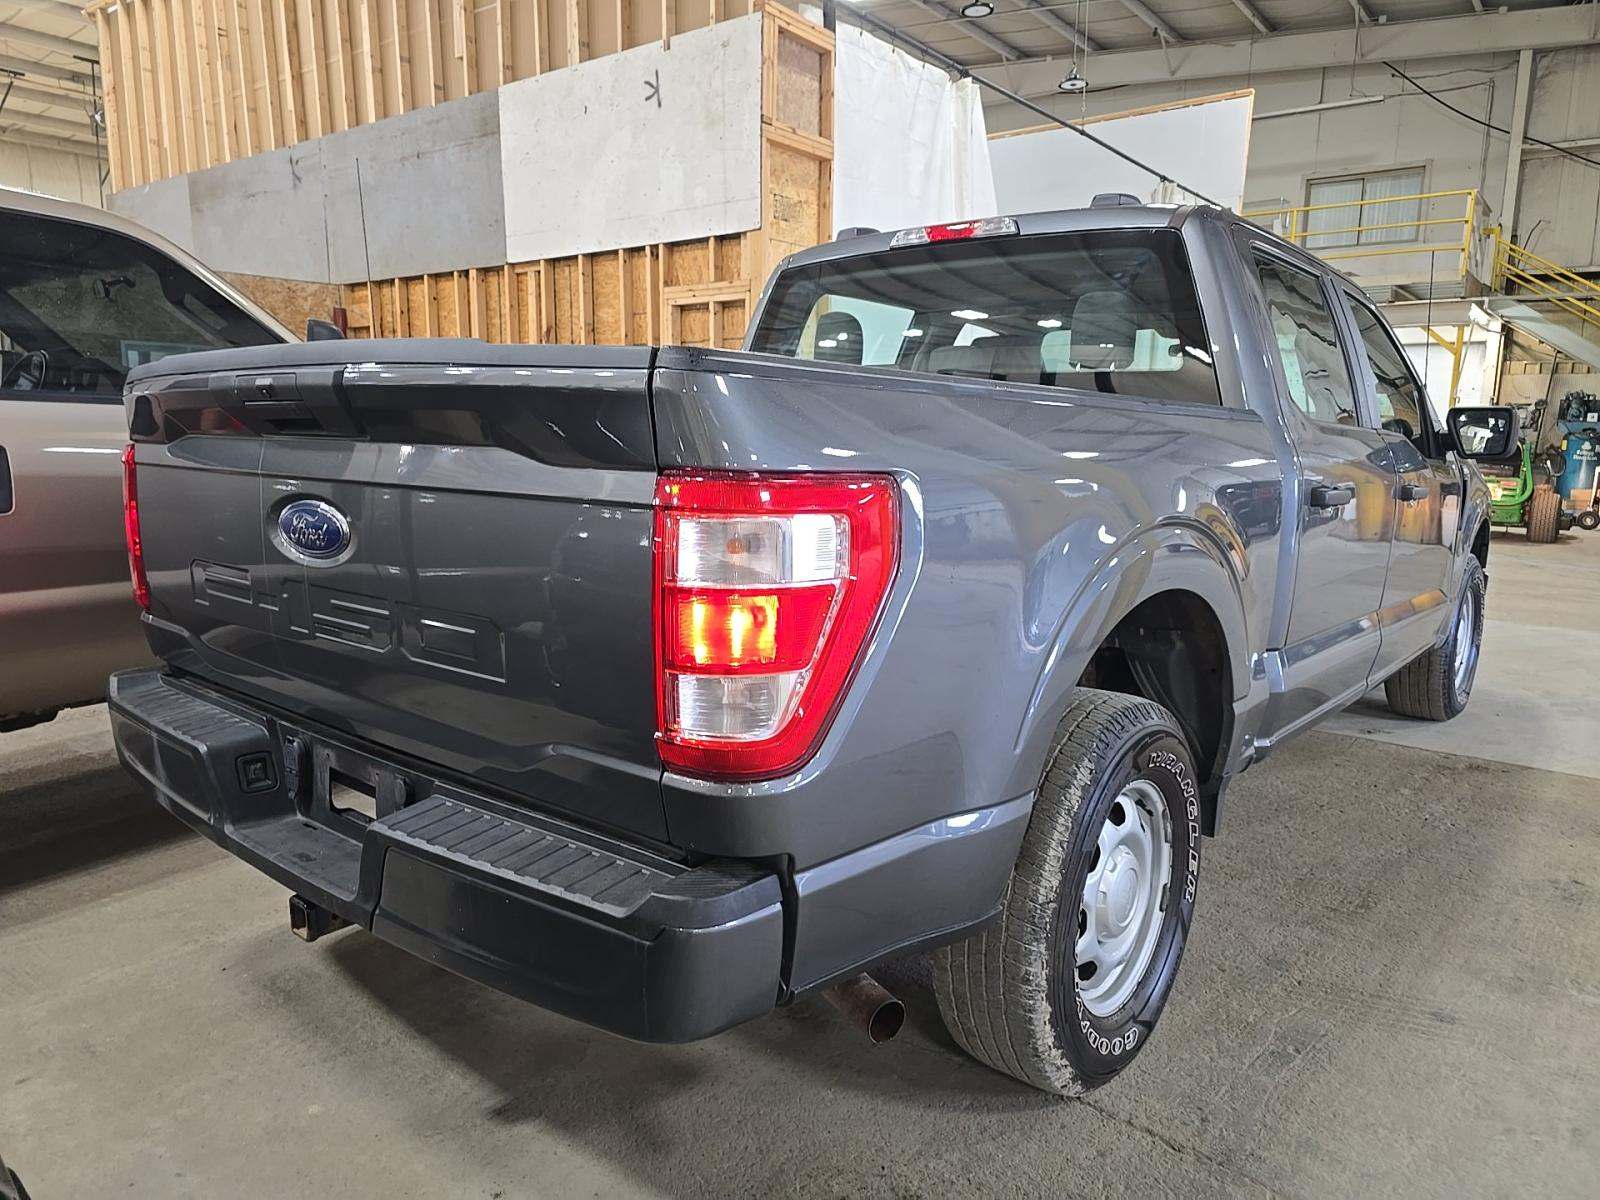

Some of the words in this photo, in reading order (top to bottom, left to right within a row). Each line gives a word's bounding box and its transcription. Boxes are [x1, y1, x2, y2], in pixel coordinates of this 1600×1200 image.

[291, 511, 328, 547] Ford
[189, 558, 506, 684] F-150
[1148, 750, 1199, 904] WRANGLER
[1074, 966, 1139, 1055] GOODY
